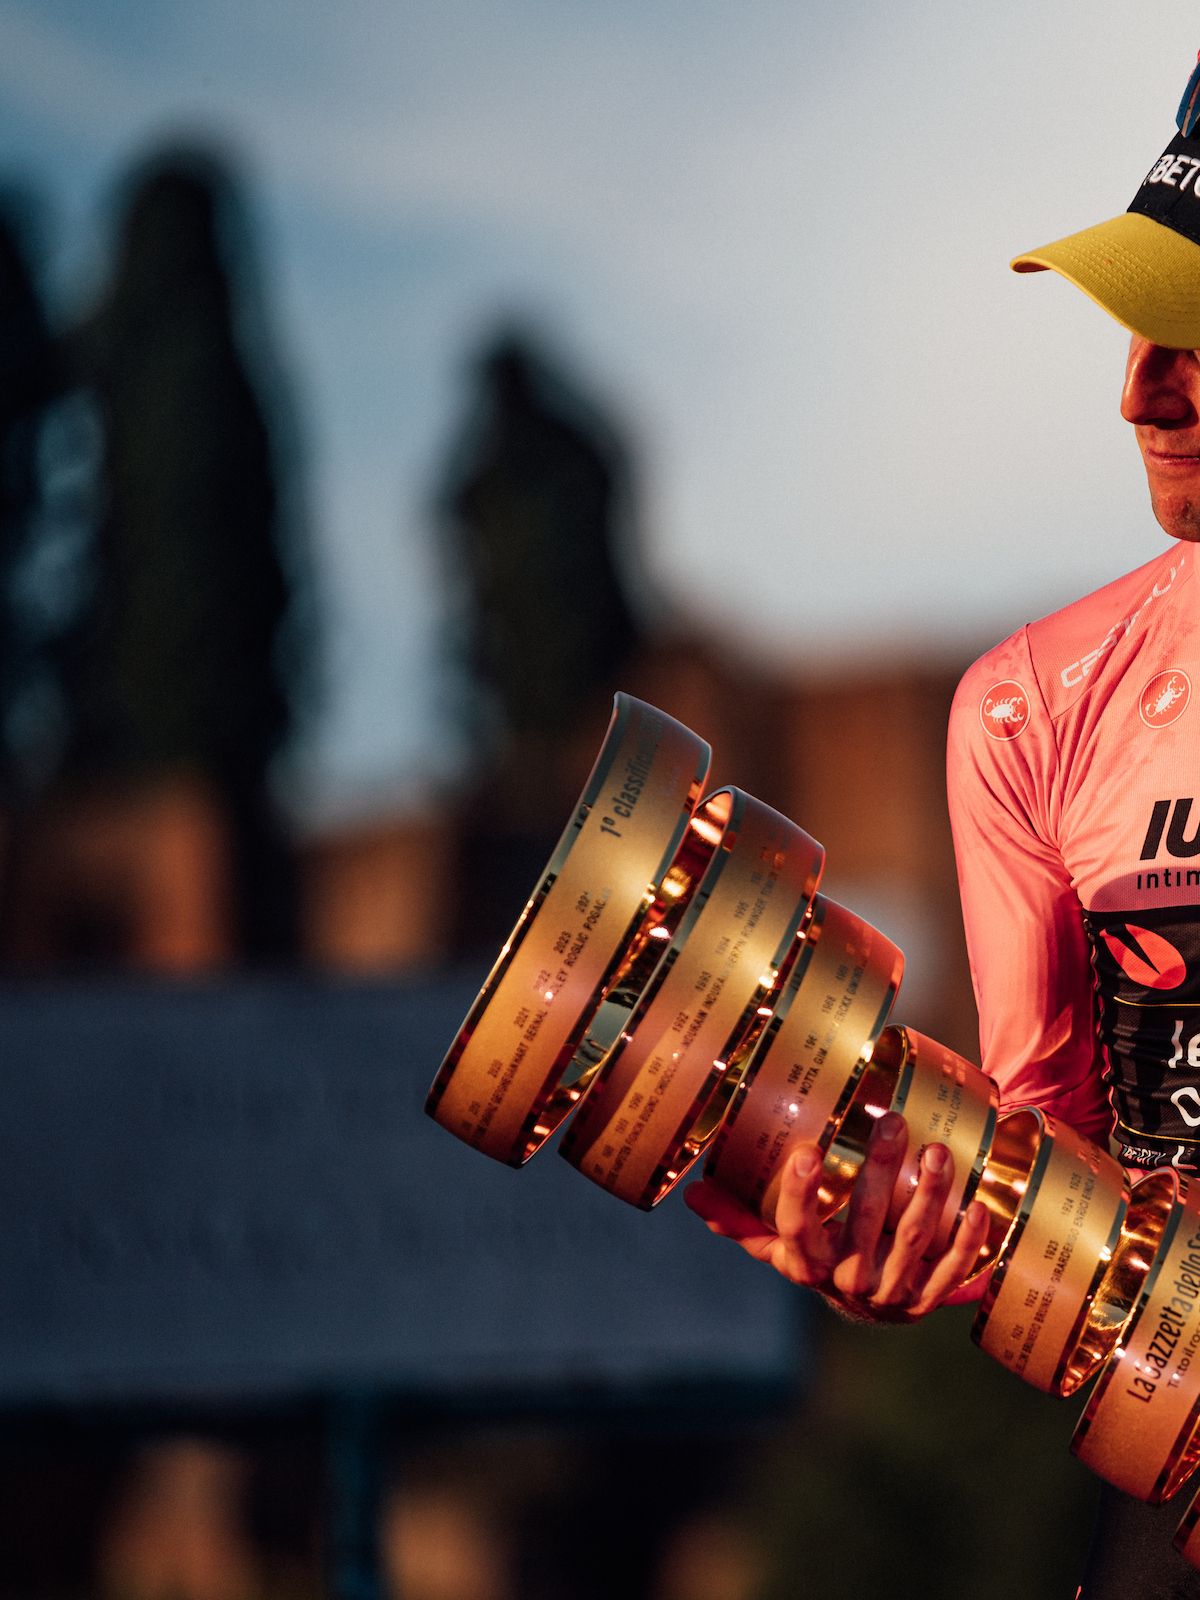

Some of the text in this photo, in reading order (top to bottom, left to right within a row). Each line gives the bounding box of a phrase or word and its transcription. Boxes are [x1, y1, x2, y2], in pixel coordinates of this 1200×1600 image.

[672, 1012, 688, 1032] 1992
[1025, 1288, 1038, 1308] 1922
[1044, 1239, 1059, 1261] 1923
[1126, 1373, 1156, 1403] La
